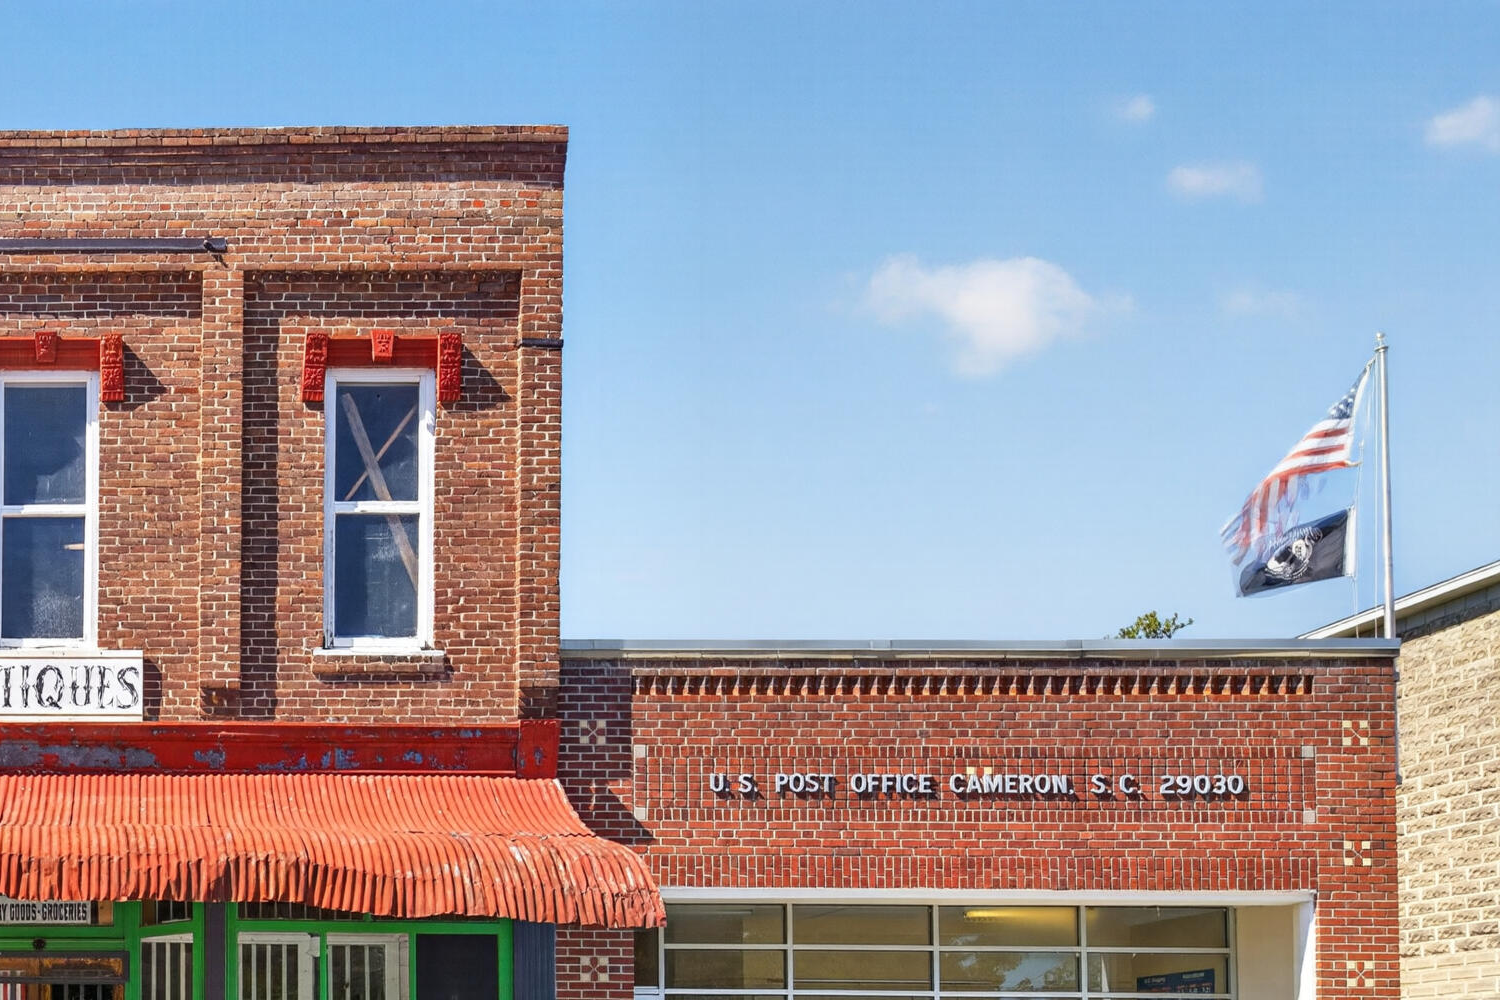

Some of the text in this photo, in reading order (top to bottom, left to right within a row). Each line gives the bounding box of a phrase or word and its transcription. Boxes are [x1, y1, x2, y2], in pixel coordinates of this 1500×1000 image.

[775, 773, 835, 793] POST
[851, 773, 934, 793] OFFICE
[1159, 774, 1244, 794] 29030
